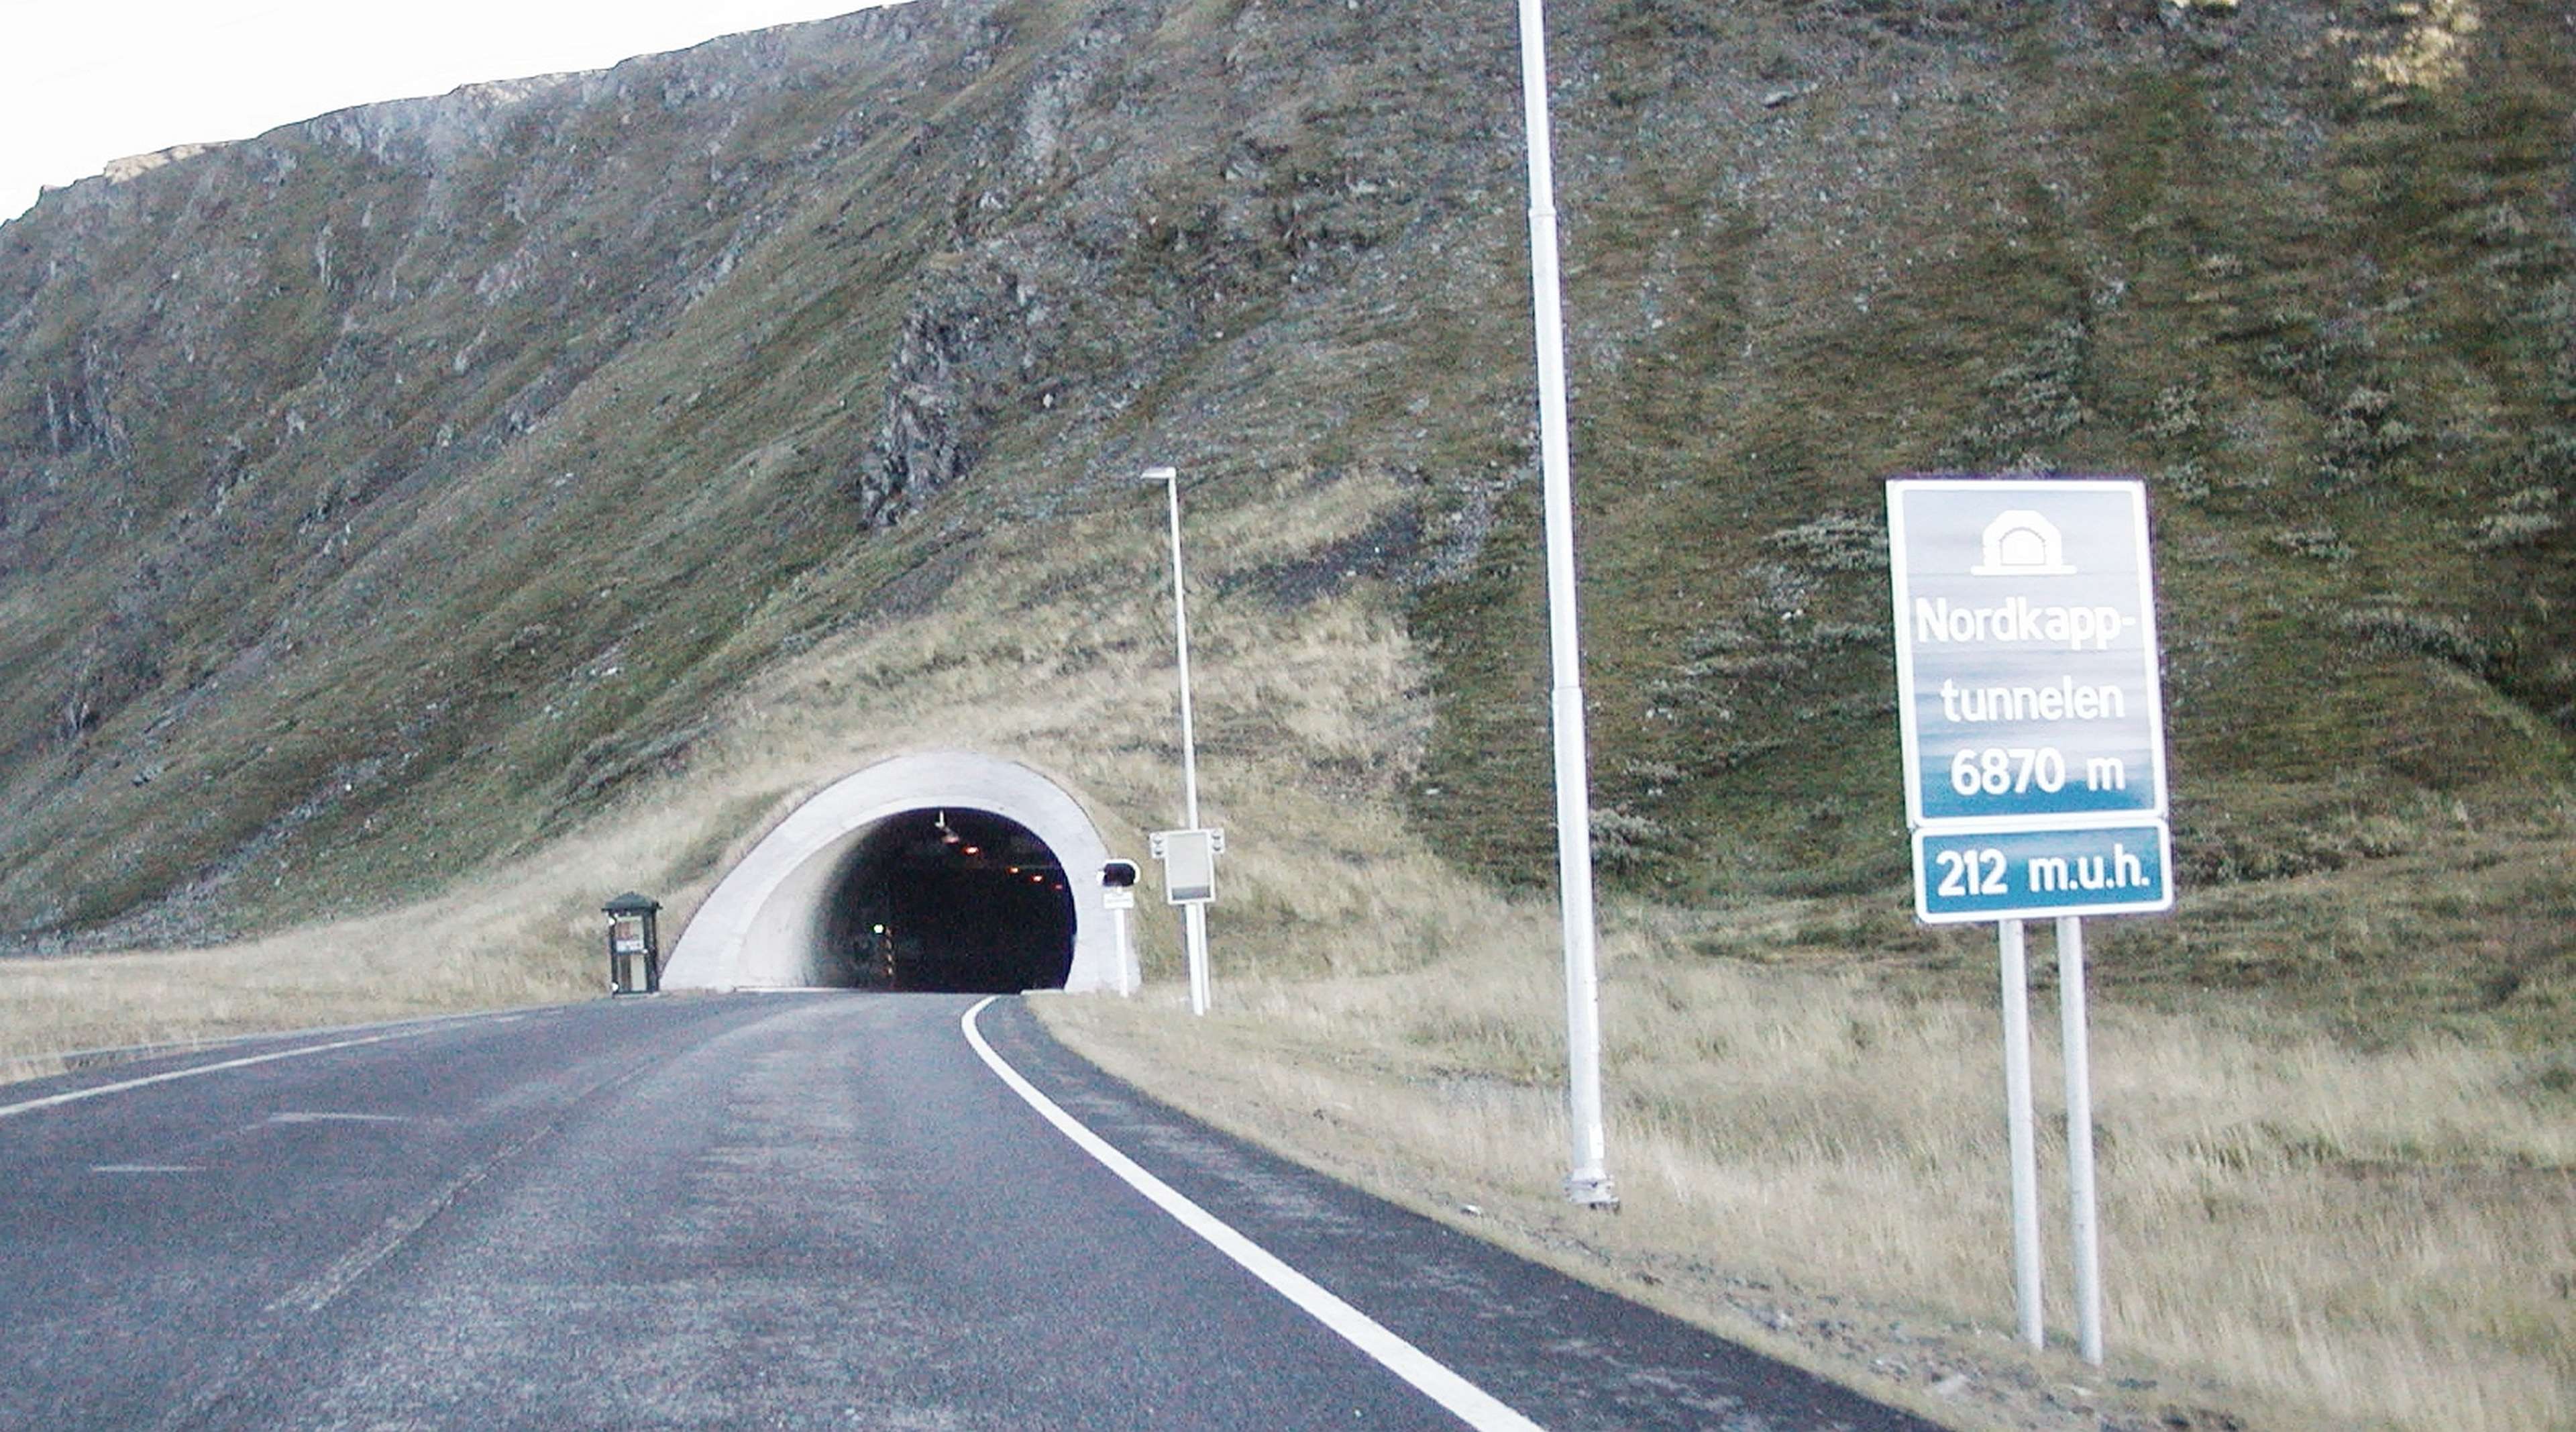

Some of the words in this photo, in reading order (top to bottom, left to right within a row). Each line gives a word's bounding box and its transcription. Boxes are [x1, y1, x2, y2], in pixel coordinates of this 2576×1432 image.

[1915, 597, 2136, 650] Nordkapp-
[1940, 675, 2125, 722] tunnelen
[1950, 747, 2065, 796] 6870
[2086, 756, 2125, 792] m
[1935, 848, 2008, 897] 212
[2028, 843, 2149, 892] m.u.h.
